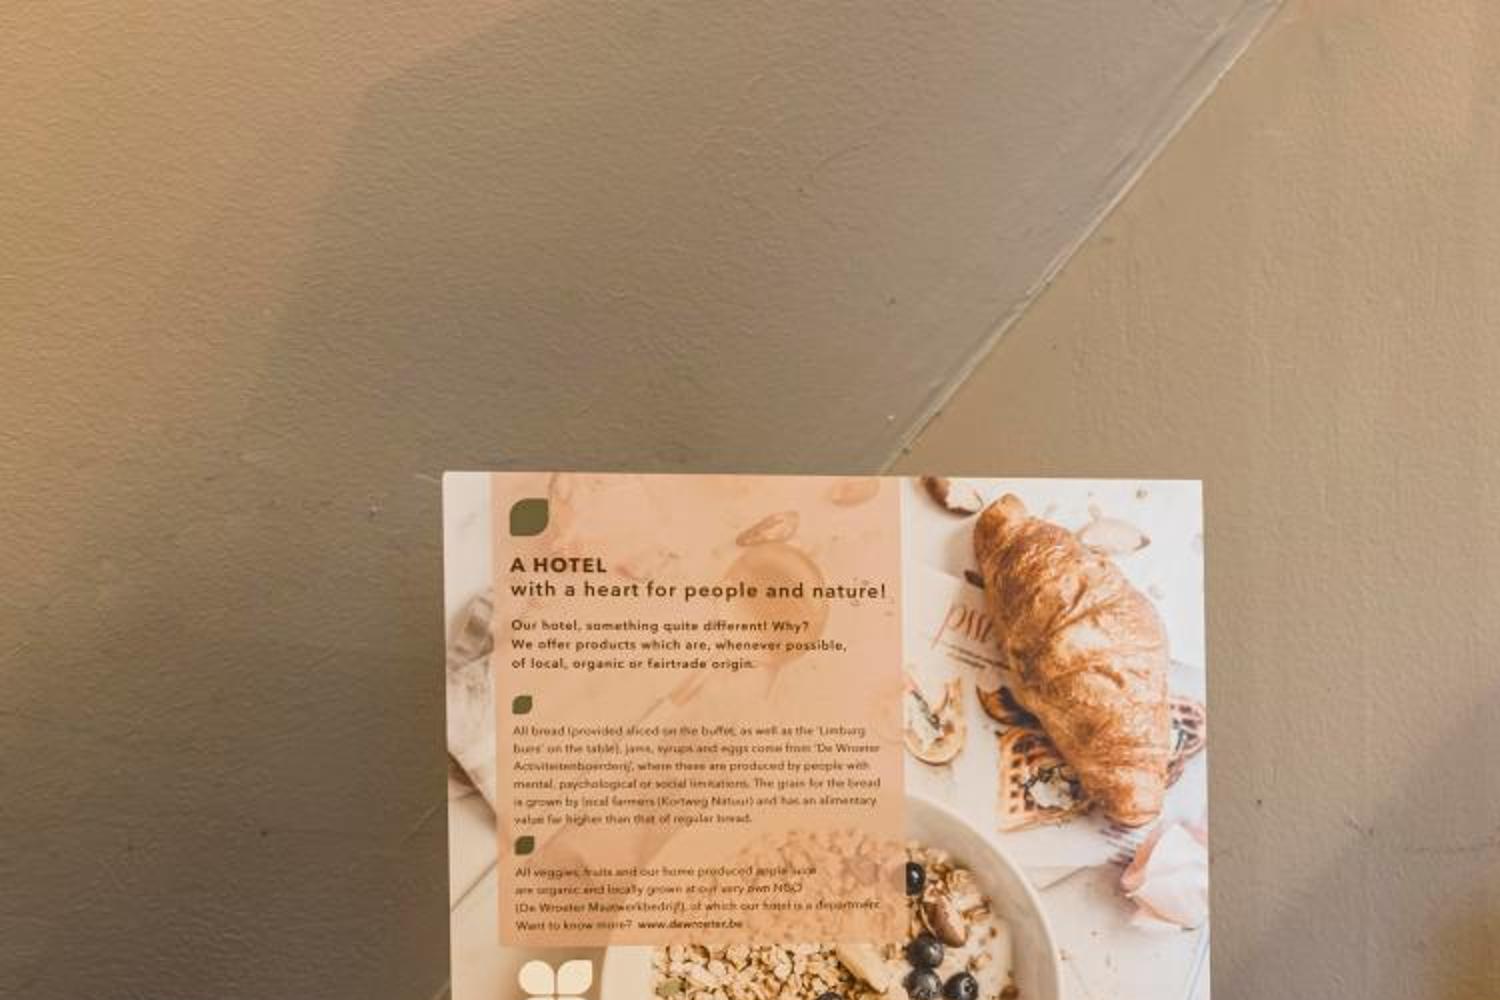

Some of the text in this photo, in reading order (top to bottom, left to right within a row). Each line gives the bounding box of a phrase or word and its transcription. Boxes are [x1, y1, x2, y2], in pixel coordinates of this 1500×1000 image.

[510, 558, 607, 574] A HOTEL
[511, 582, 886, 602] with a heart for people and nature!
